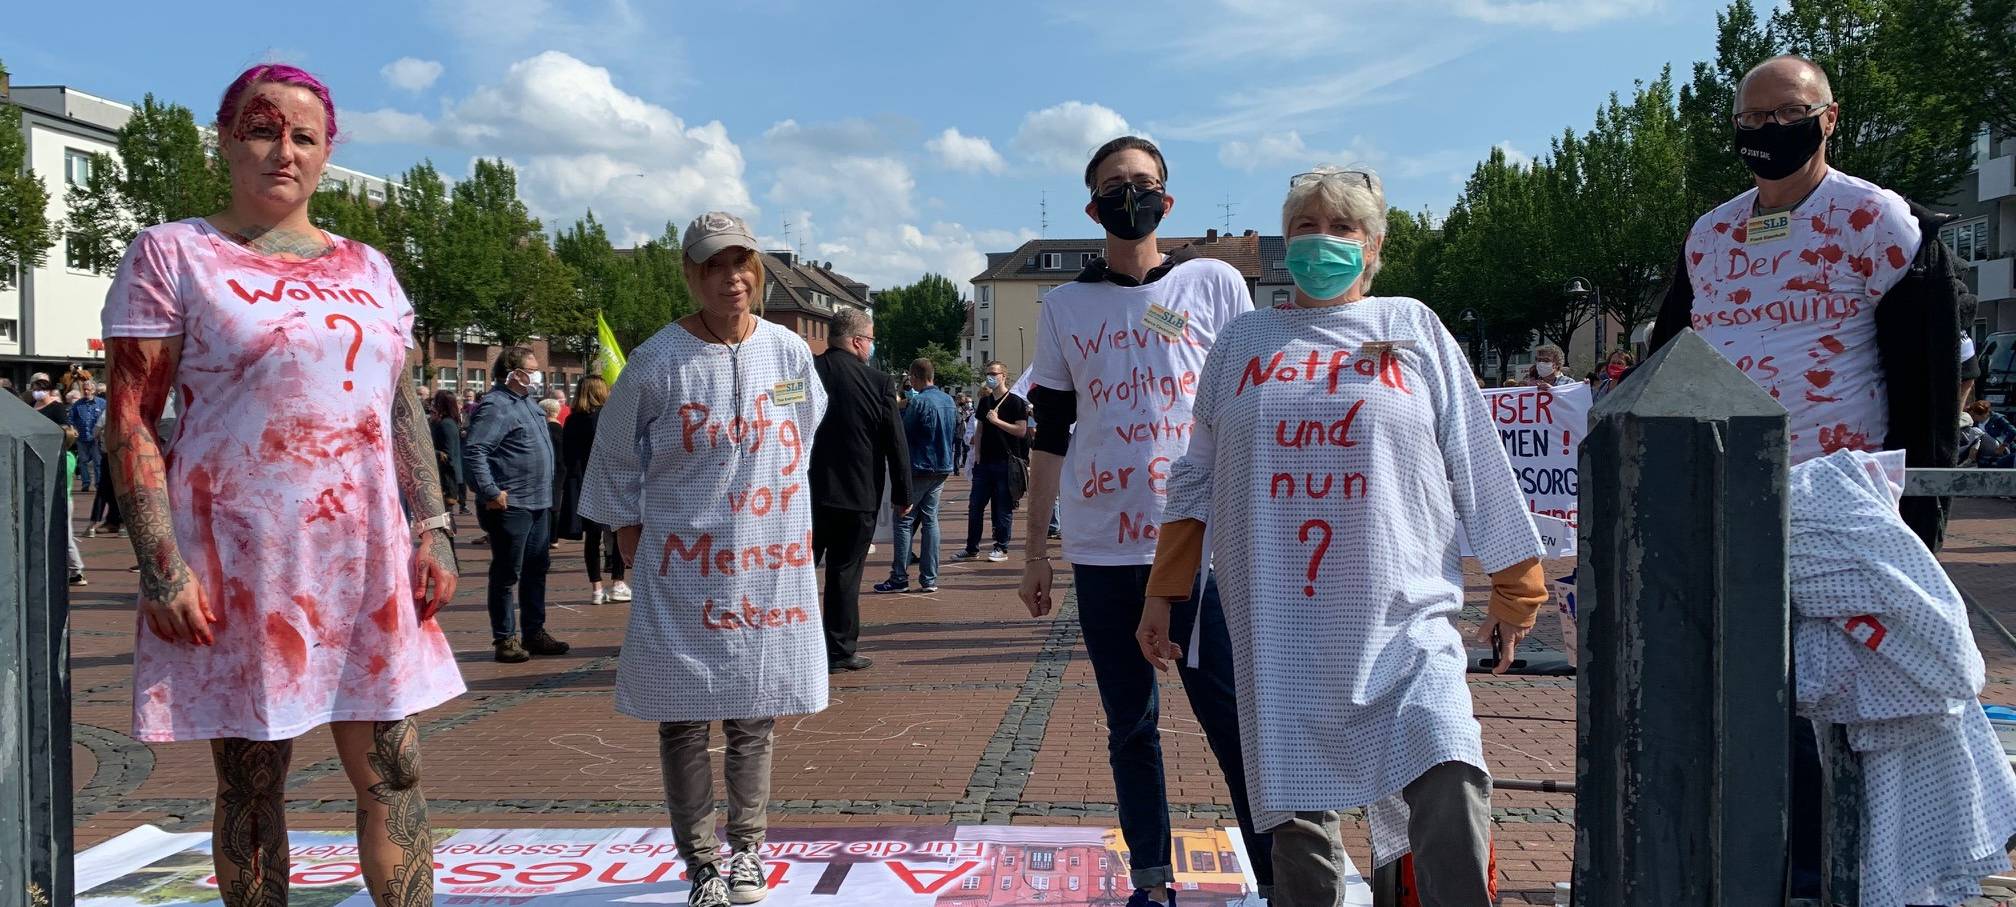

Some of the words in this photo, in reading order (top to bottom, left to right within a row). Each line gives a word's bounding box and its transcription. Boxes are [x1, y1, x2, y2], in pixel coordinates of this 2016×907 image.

[1763, 217, 1788, 229] SLB
[1727, 248, 1791, 279] Der
[226, 279, 384, 309] Wohin
[1161, 311, 1184, 328] SLB
[325, 313, 363, 392] ?
[786, 381, 803, 392] SLB
[1235, 350, 1412, 397] Notfall
[1276, 399, 1366, 448] und
[1499, 429, 1549, 457] MEN
[1082, 455, 1135, 498] der
[1271, 472, 1367, 499] nun
[728, 484, 800, 517] vor
[1298, 519, 1332, 598] ?
[606, 843, 677, 858] des
[849, 841, 907, 857] die
[918, 841, 984, 858] Für
